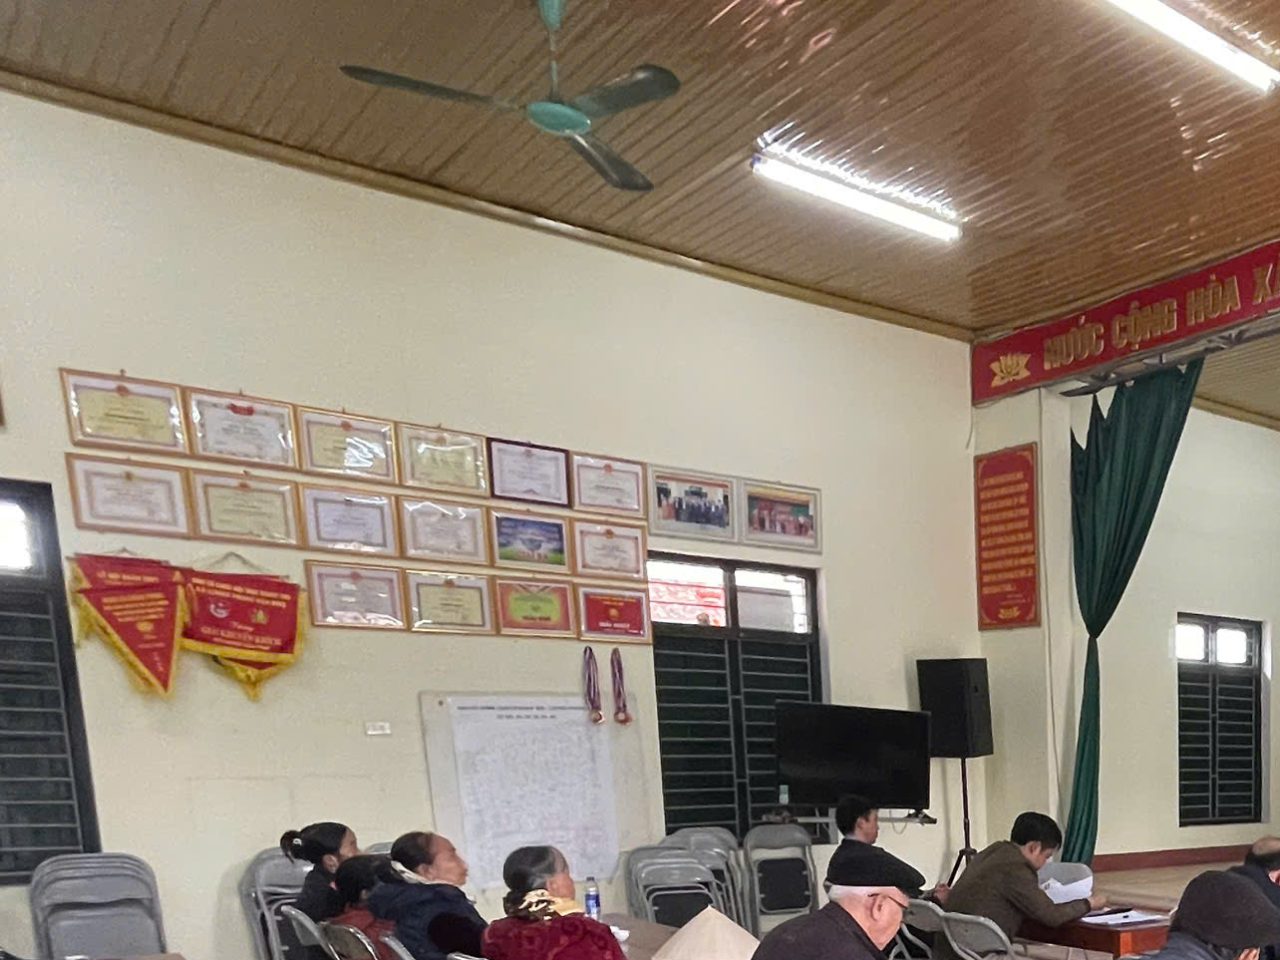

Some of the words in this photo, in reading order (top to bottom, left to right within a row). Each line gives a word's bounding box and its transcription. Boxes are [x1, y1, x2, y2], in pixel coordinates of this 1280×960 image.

[1043, 315, 1104, 371] NƯỚC
[1111, 301, 1177, 351] CỘNG
[1186, 273, 1241, 326] HÒA
